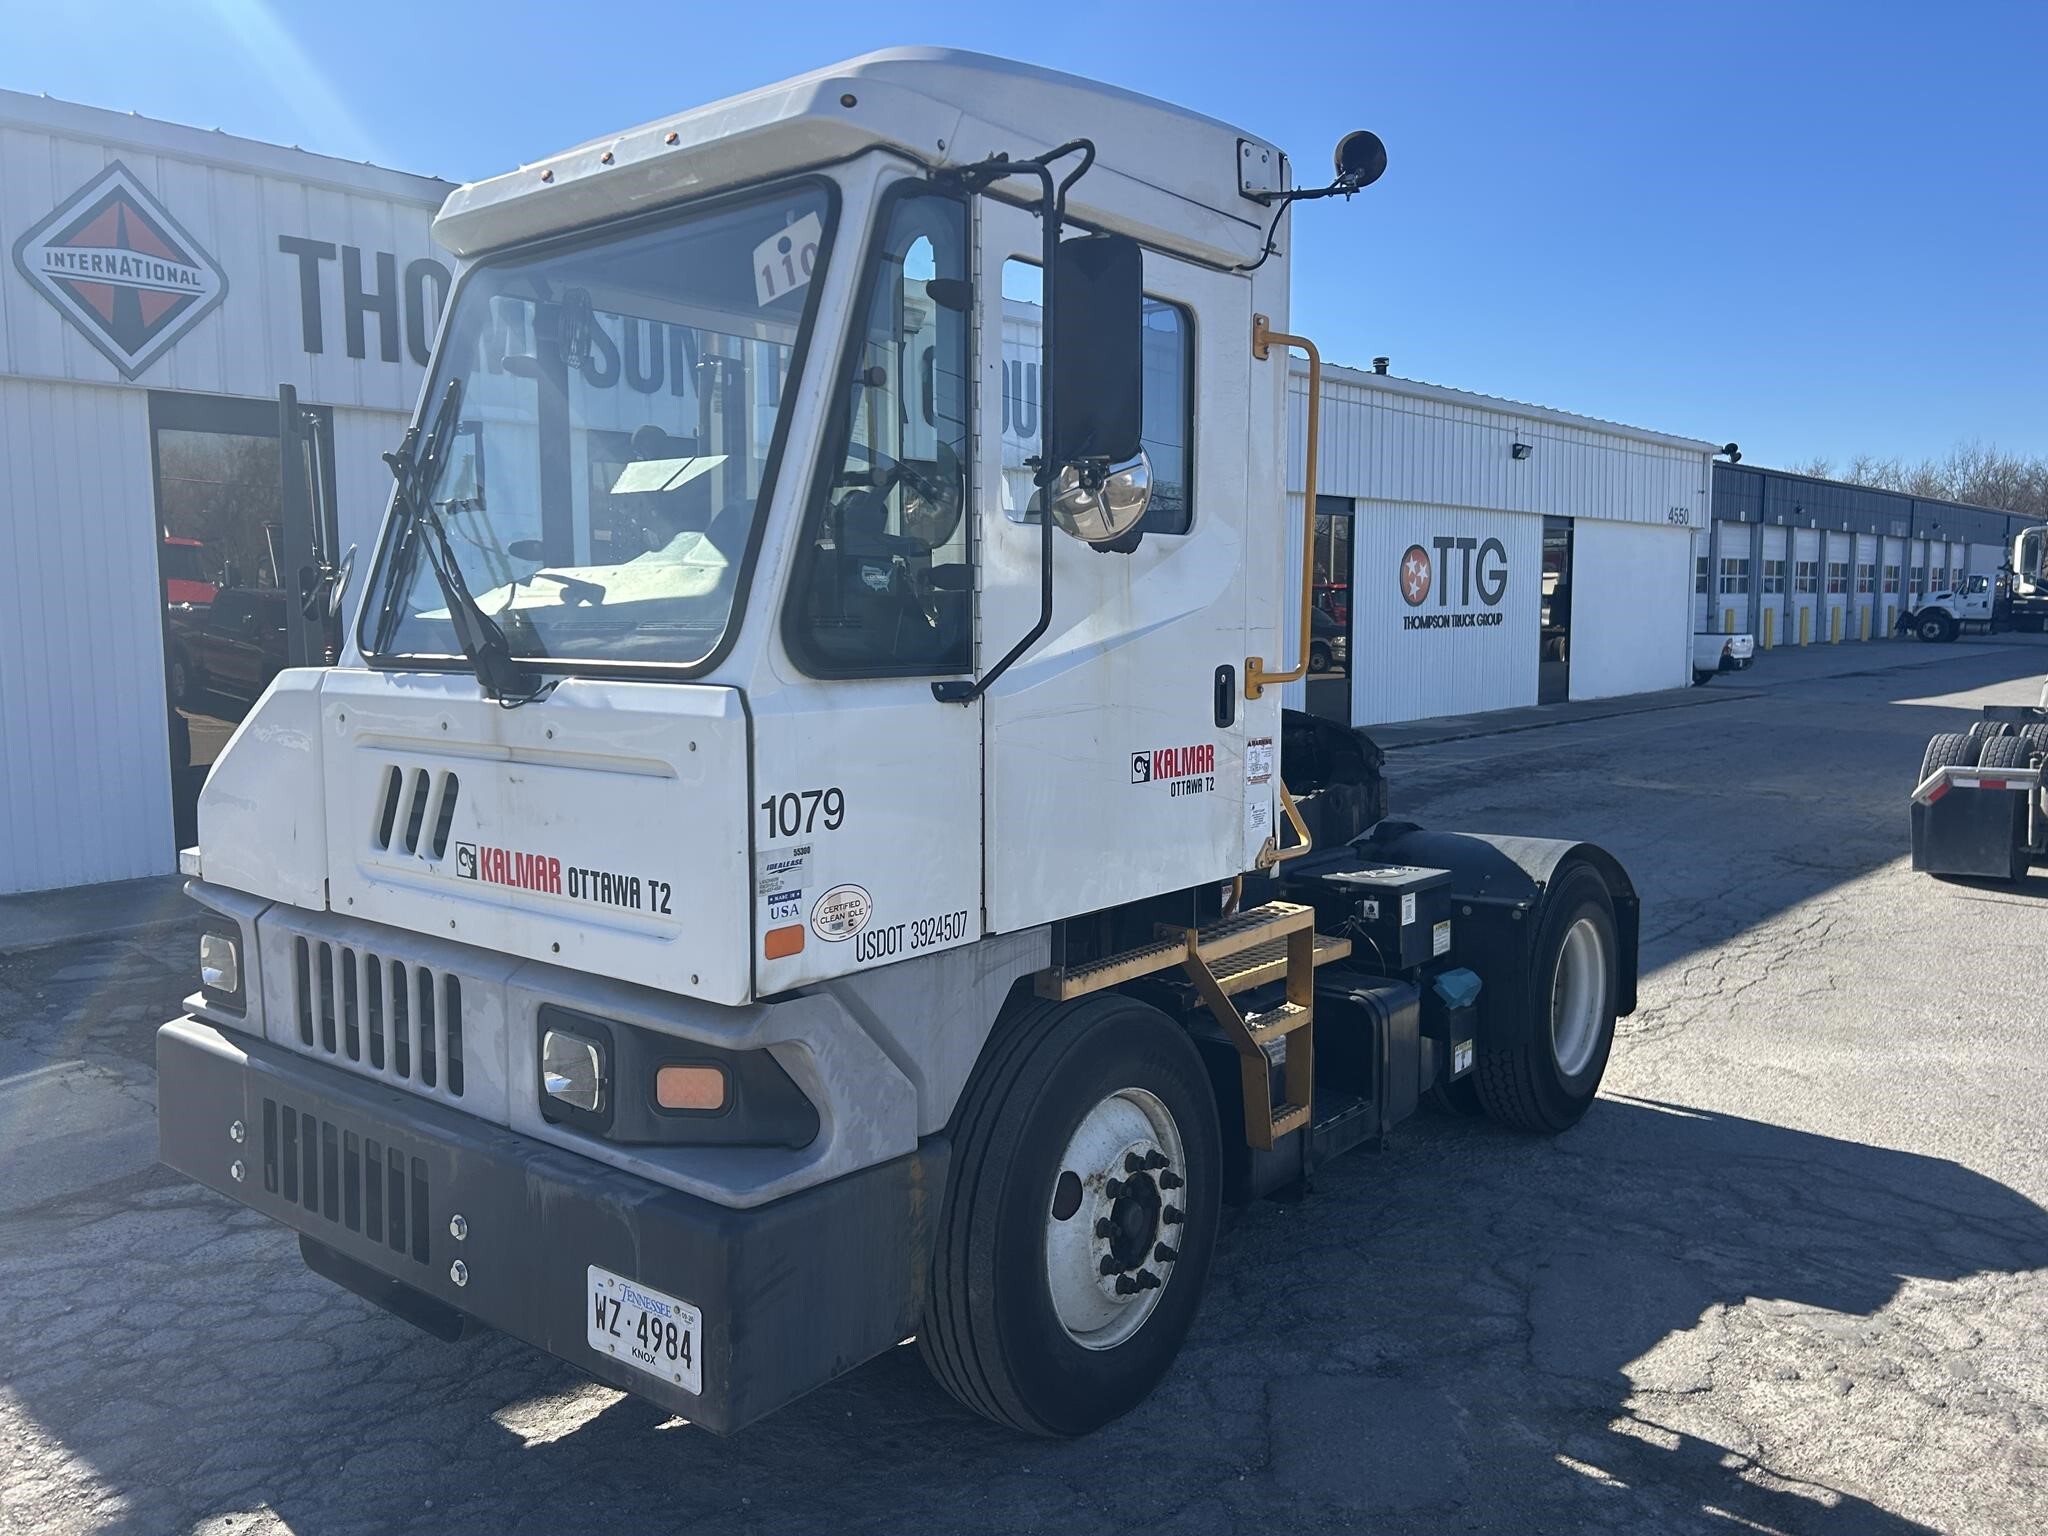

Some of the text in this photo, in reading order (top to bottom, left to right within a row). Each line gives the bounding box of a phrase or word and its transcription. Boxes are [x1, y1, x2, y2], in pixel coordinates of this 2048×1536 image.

[46, 252, 201, 286] INTERNATIONAL
[1668, 507, 1689, 525] 4550
[1403, 613, 1503, 630] THOMPSON TRUCK GROUP
[1153, 744, 1214, 780] KALMAR
[1170, 776, 1215, 797] OTTAWA T2
[761, 787, 845, 838] 1079
[766, 859, 804, 871] IDEALEASE
[480, 846, 672, 914] KALMAR OTTAWA T2
[770, 903, 800, 920] USA
[820, 908, 864, 924] CLEAN IDLE
[823, 899, 861, 915] CERTIFIED
[856, 910, 968, 962] USDOT 3924507
[618, 1283, 672, 1318] TENNESSEE
[631, 1346, 656, 1365] KNOX
